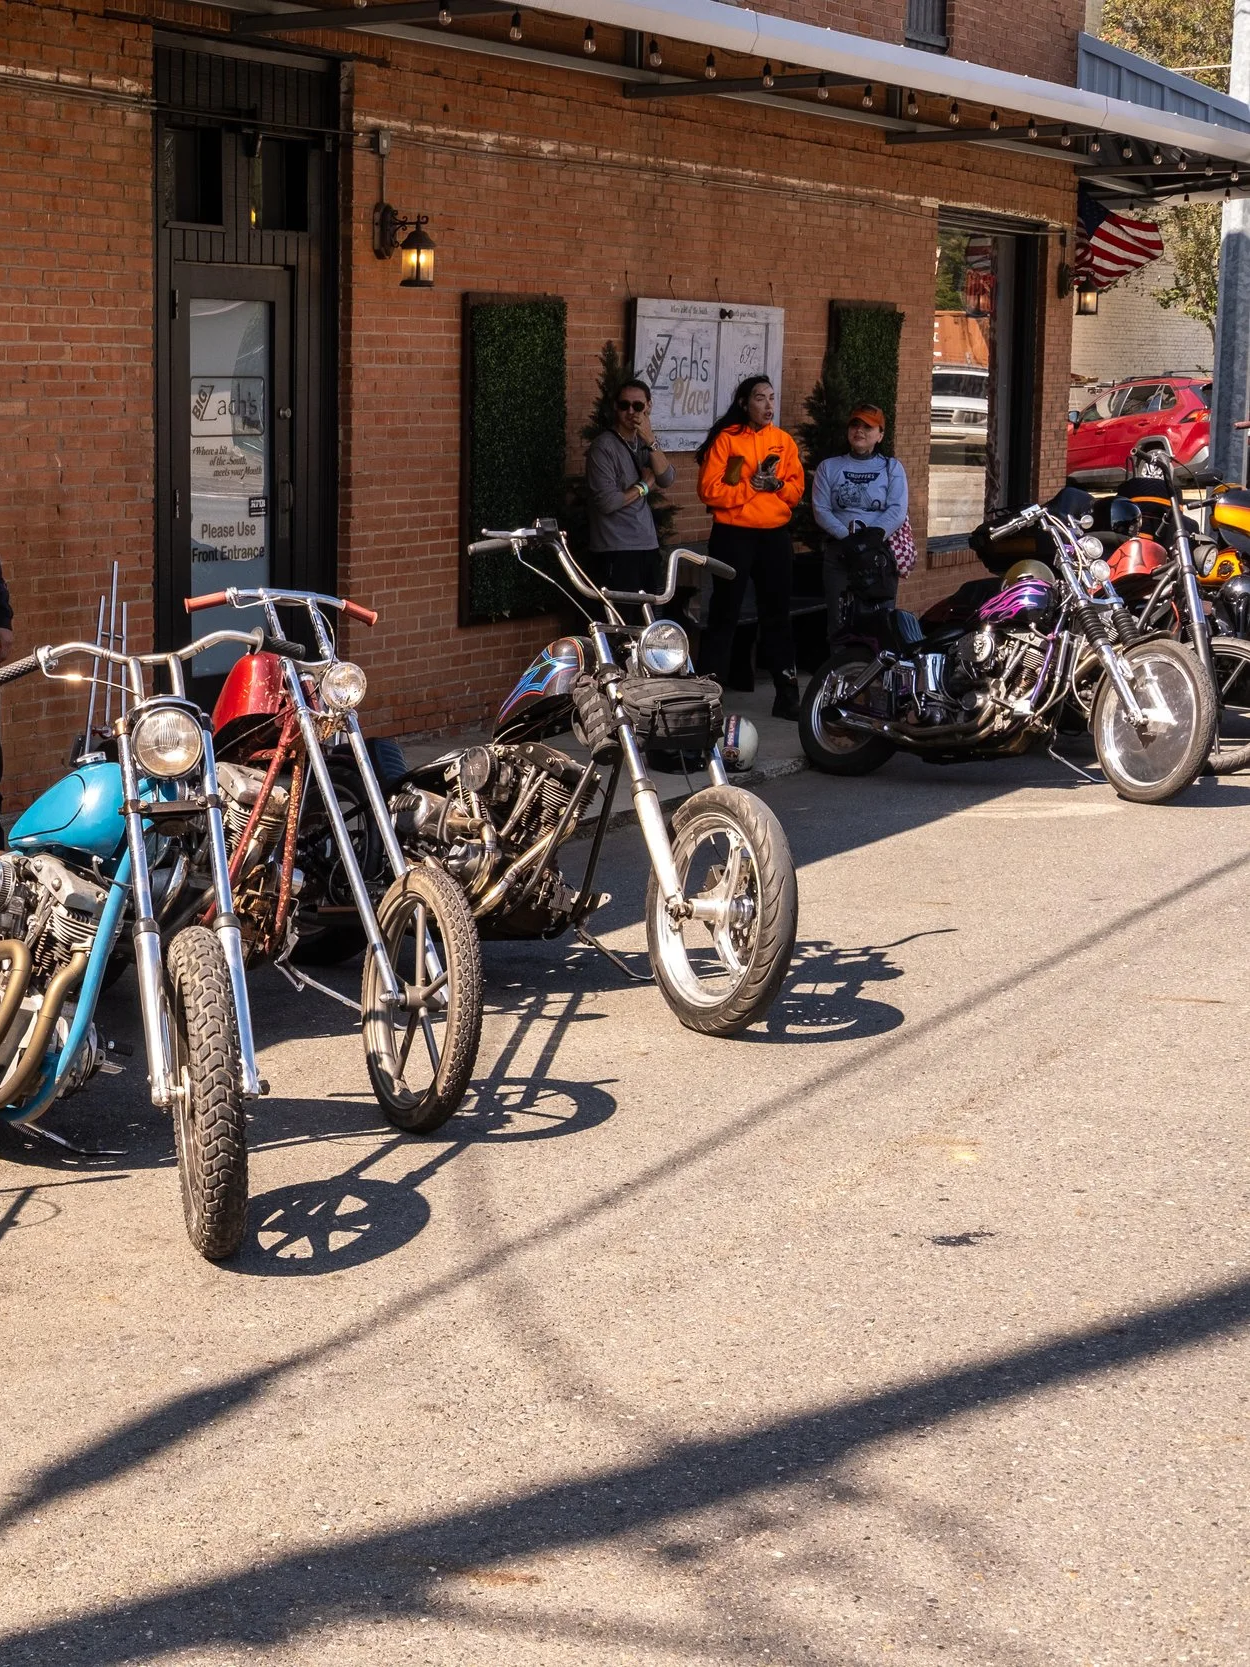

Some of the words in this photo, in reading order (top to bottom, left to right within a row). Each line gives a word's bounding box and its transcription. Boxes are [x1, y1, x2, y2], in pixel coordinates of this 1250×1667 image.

[646, 342, 666, 385] BIG
[192, 388, 208, 420] BIG
[671, 377, 710, 417] Place
[192, 445, 214, 455] Where
[219, 445, 228, 455] bit
[217, 456, 226, 466] the
[213, 468, 230, 477] meets
[201, 523, 235, 539] Please
[237, 521, 256, 537] Use
[192, 545, 219, 563] Front
[220, 544, 266, 561] Entrance
